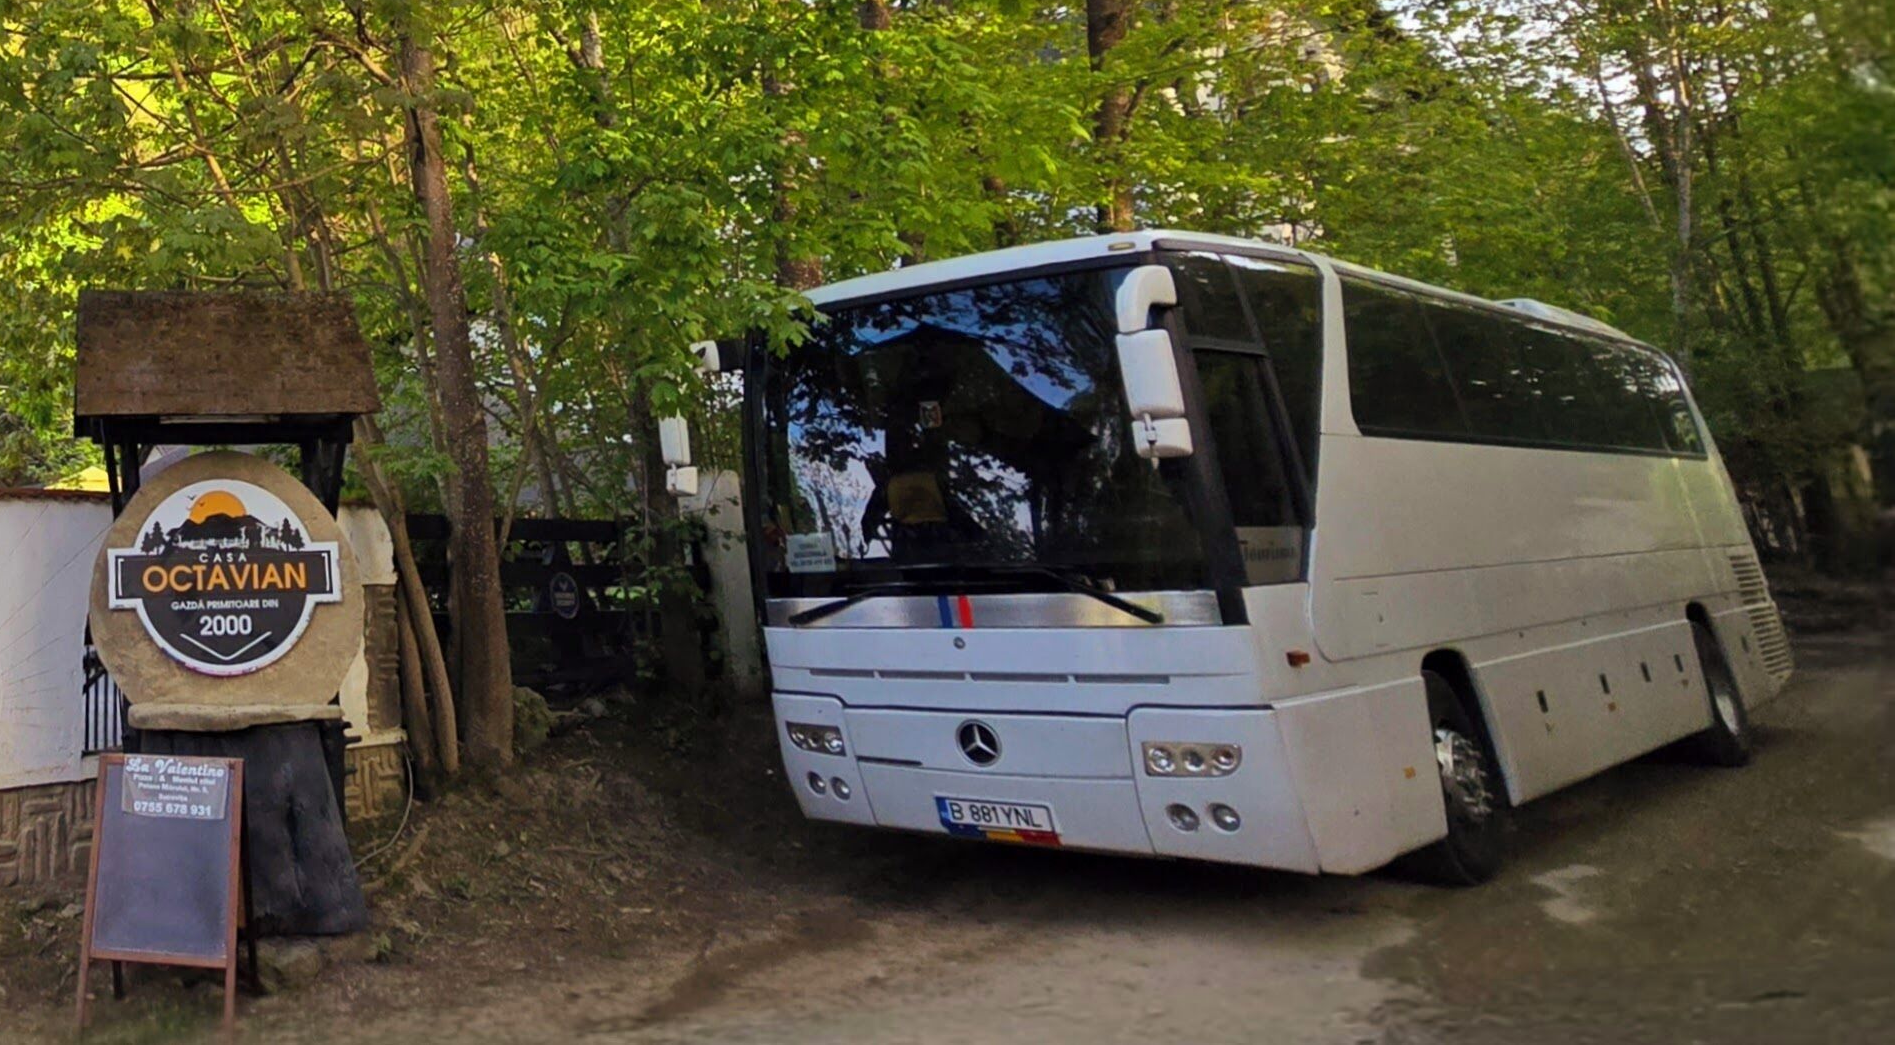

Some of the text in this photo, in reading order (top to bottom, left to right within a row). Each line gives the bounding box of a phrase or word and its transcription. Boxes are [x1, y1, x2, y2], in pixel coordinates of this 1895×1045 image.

[199, 552, 247, 563] CASA
[142, 562, 307, 593] OCTAVIAN
[207, 598, 260, 610] PRIMITOARE
[262, 598, 279, 608] DIN
[199, 614, 253, 636] 2000
[126, 757, 225, 777] La Valentino
[159, 774, 166, 782] &
[134, 801, 212, 816] 0755 678 931
[949, 802, 1043, 828] B 881 YNL
